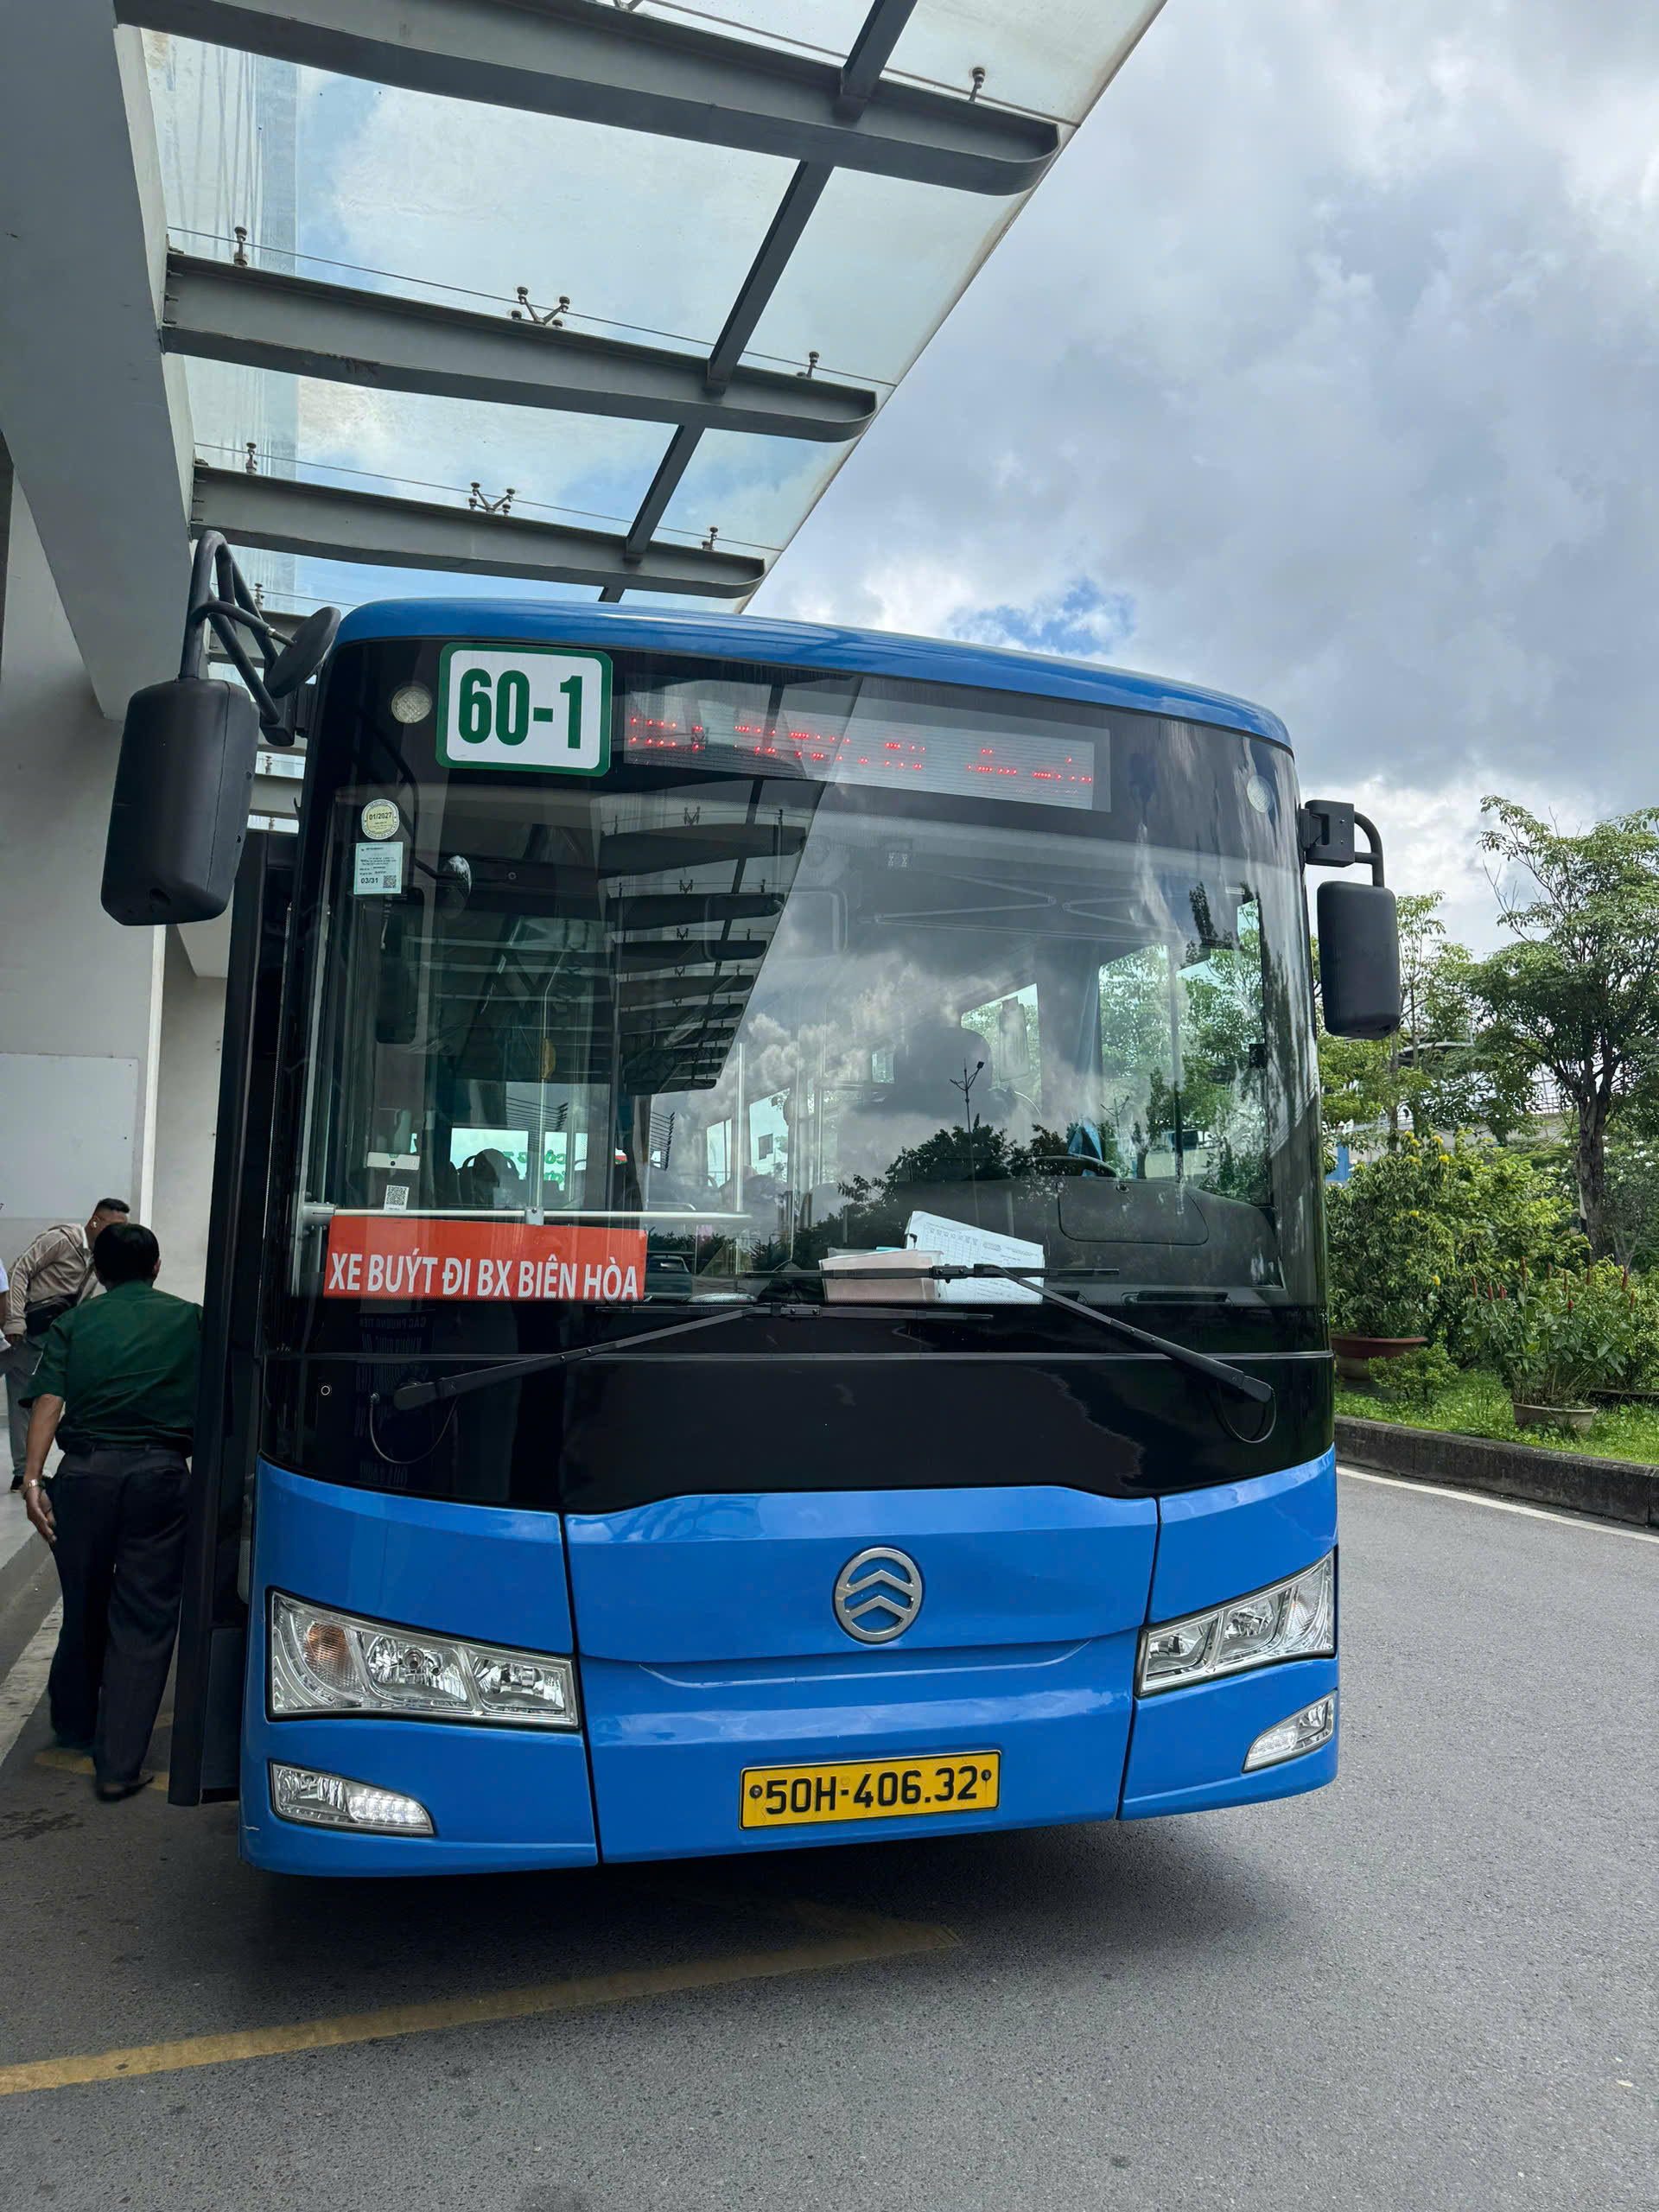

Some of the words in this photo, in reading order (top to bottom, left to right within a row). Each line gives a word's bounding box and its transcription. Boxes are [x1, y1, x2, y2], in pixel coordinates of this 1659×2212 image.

[458, 668, 583, 750] 60-1
[368, 811, 393, 821] 01/2027
[328, 1252, 363, 1290] XE
[367, 1248, 438, 1294] BUÝT
[442, 1257, 471, 1295] ĐI
[477, 1259, 512, 1297] BX
[518, 1253, 578, 1300] BIÊN
[583, 1256, 639, 1301] HÒA
[766, 1765, 979, 1815] 50H-406.32
